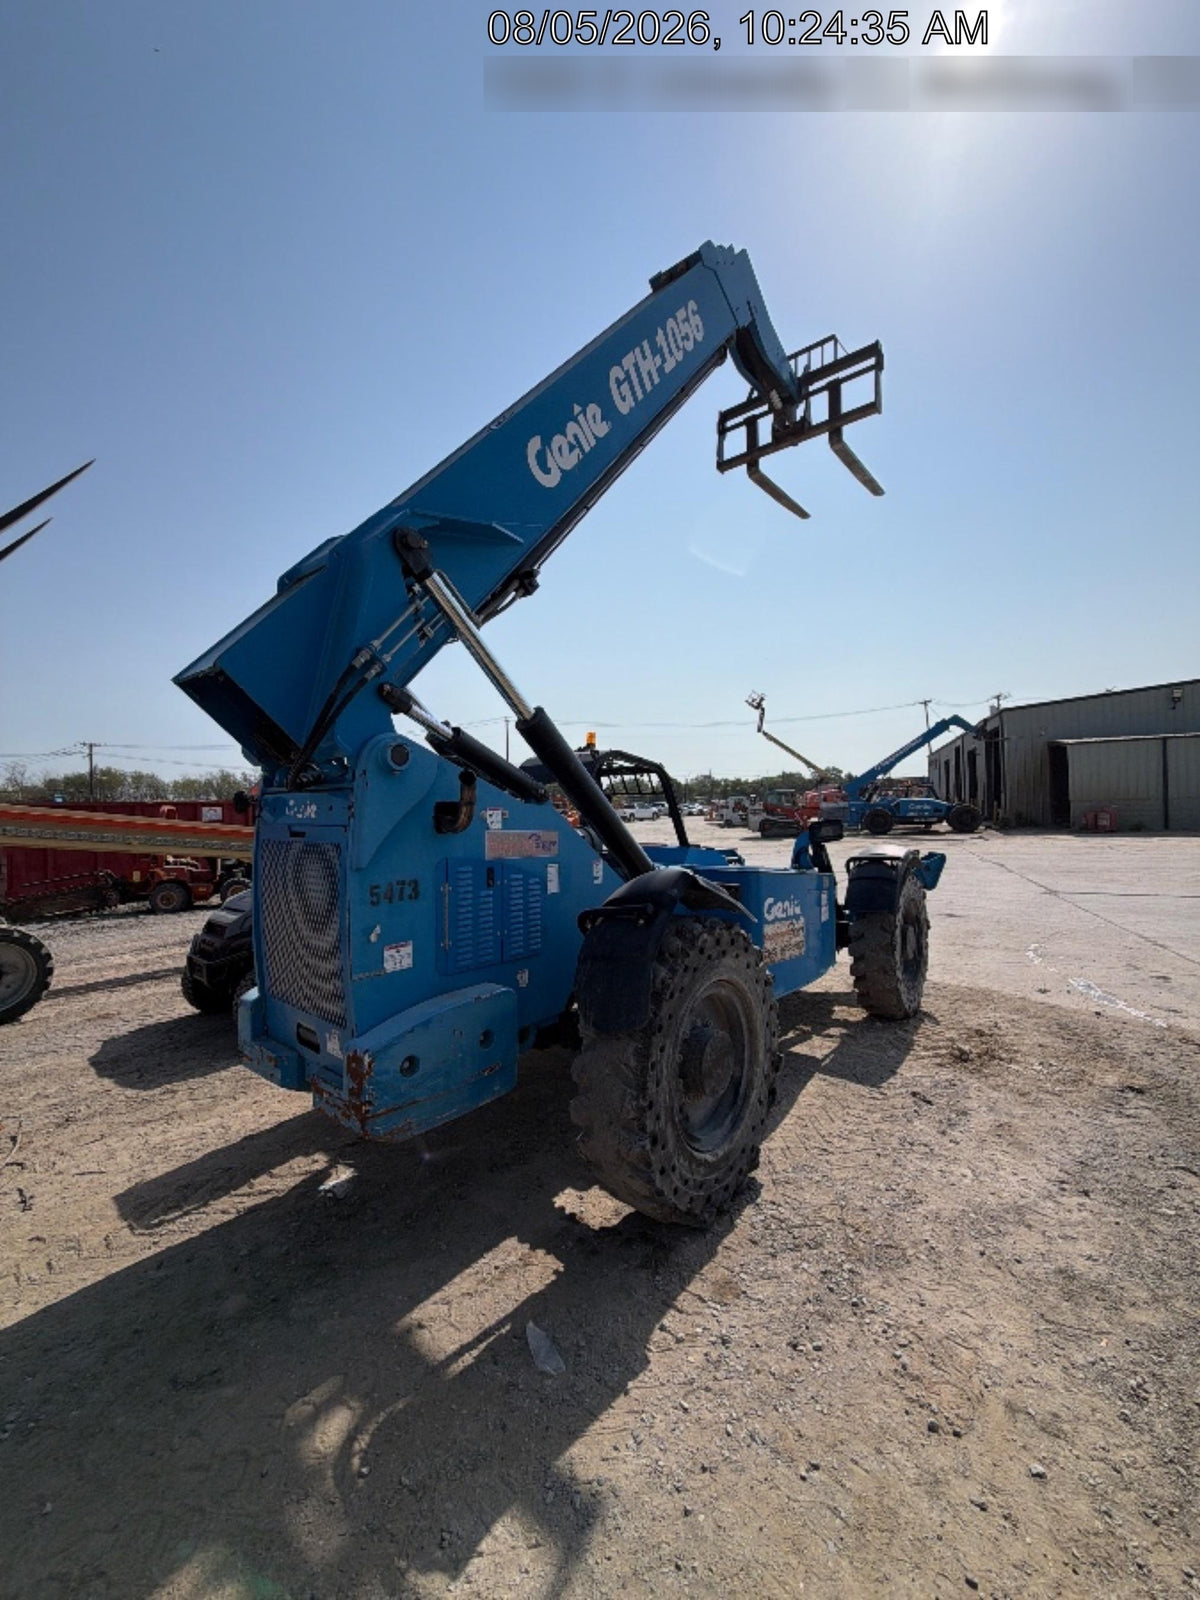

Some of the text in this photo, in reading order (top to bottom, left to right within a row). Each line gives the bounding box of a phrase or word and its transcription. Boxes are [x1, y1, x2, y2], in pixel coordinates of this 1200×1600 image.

[527, 300, 704, 488] Genie GTH-1056
[369, 879, 421, 907] 5473
